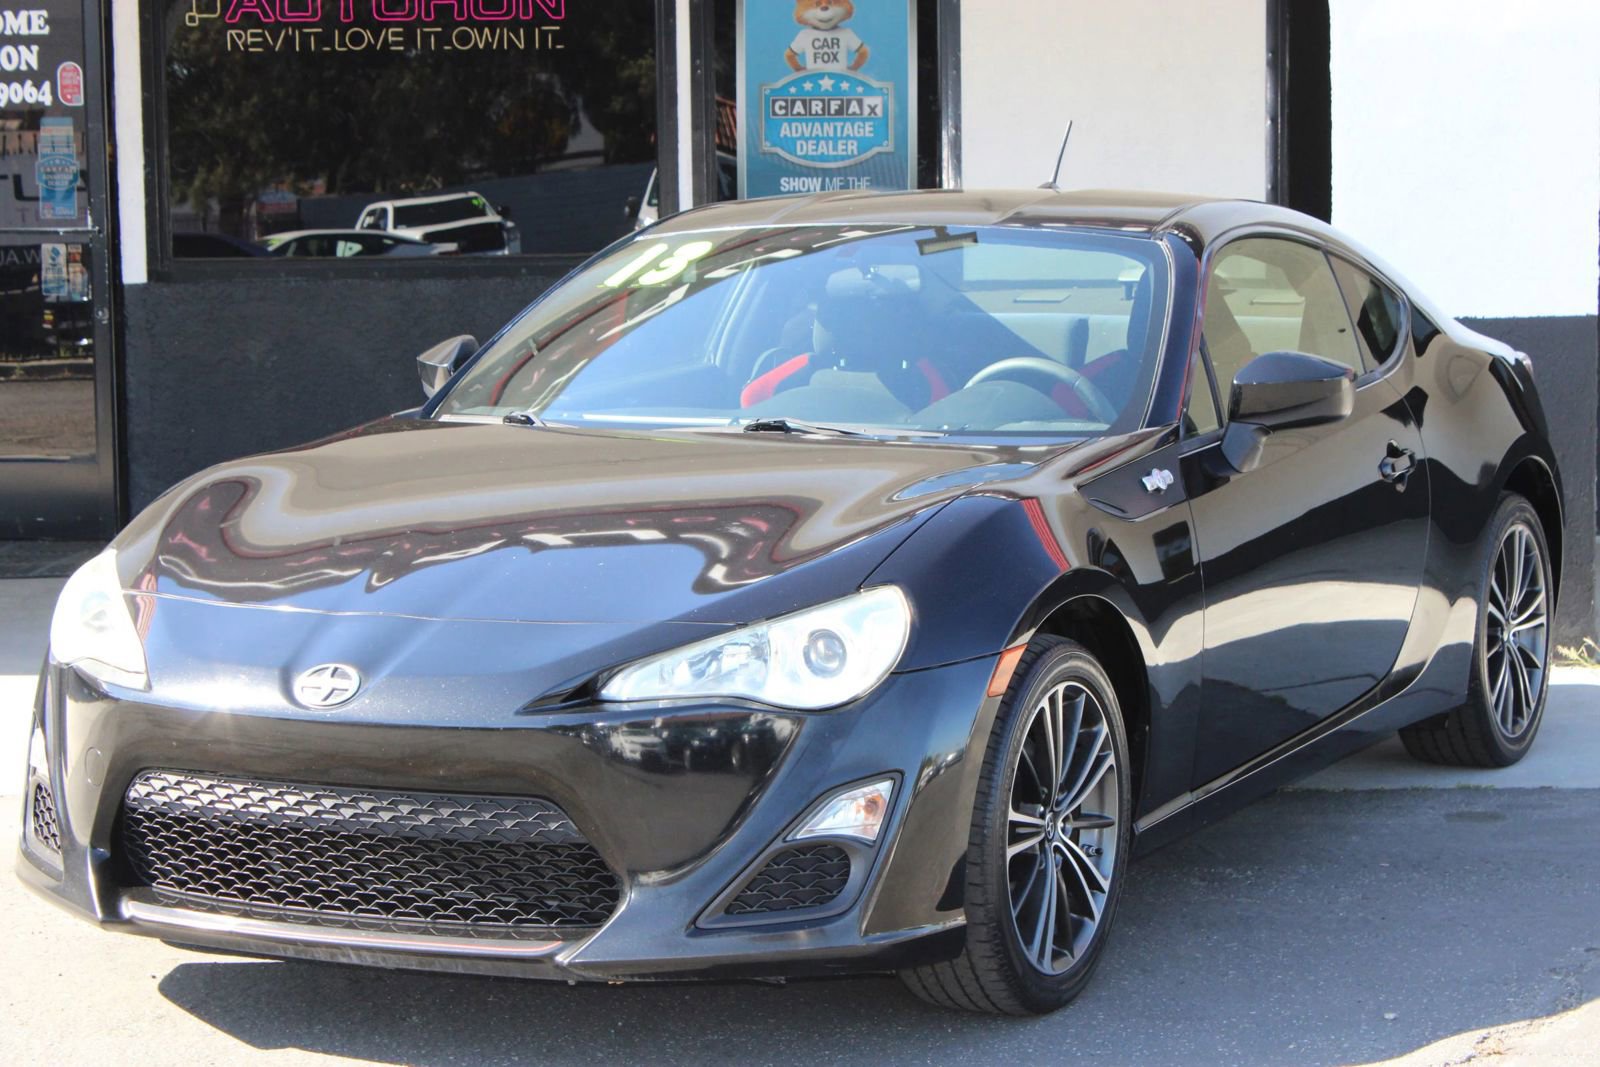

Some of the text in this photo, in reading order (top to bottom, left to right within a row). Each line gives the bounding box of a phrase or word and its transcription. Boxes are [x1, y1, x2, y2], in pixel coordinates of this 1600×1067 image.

[0, 10, 50, 35] ME
[812, 38, 841, 51] CAR
[0, 44, 40, 71] ON
[813, 52, 840, 64] FOX
[773, 98, 881, 118] CARFAX
[779, 122, 874, 138] ADVANTAGE
[796, 140, 859, 156] DEALER
[780, 177, 872, 192] SHOW ME THE
[602, 240, 713, 288] 13
